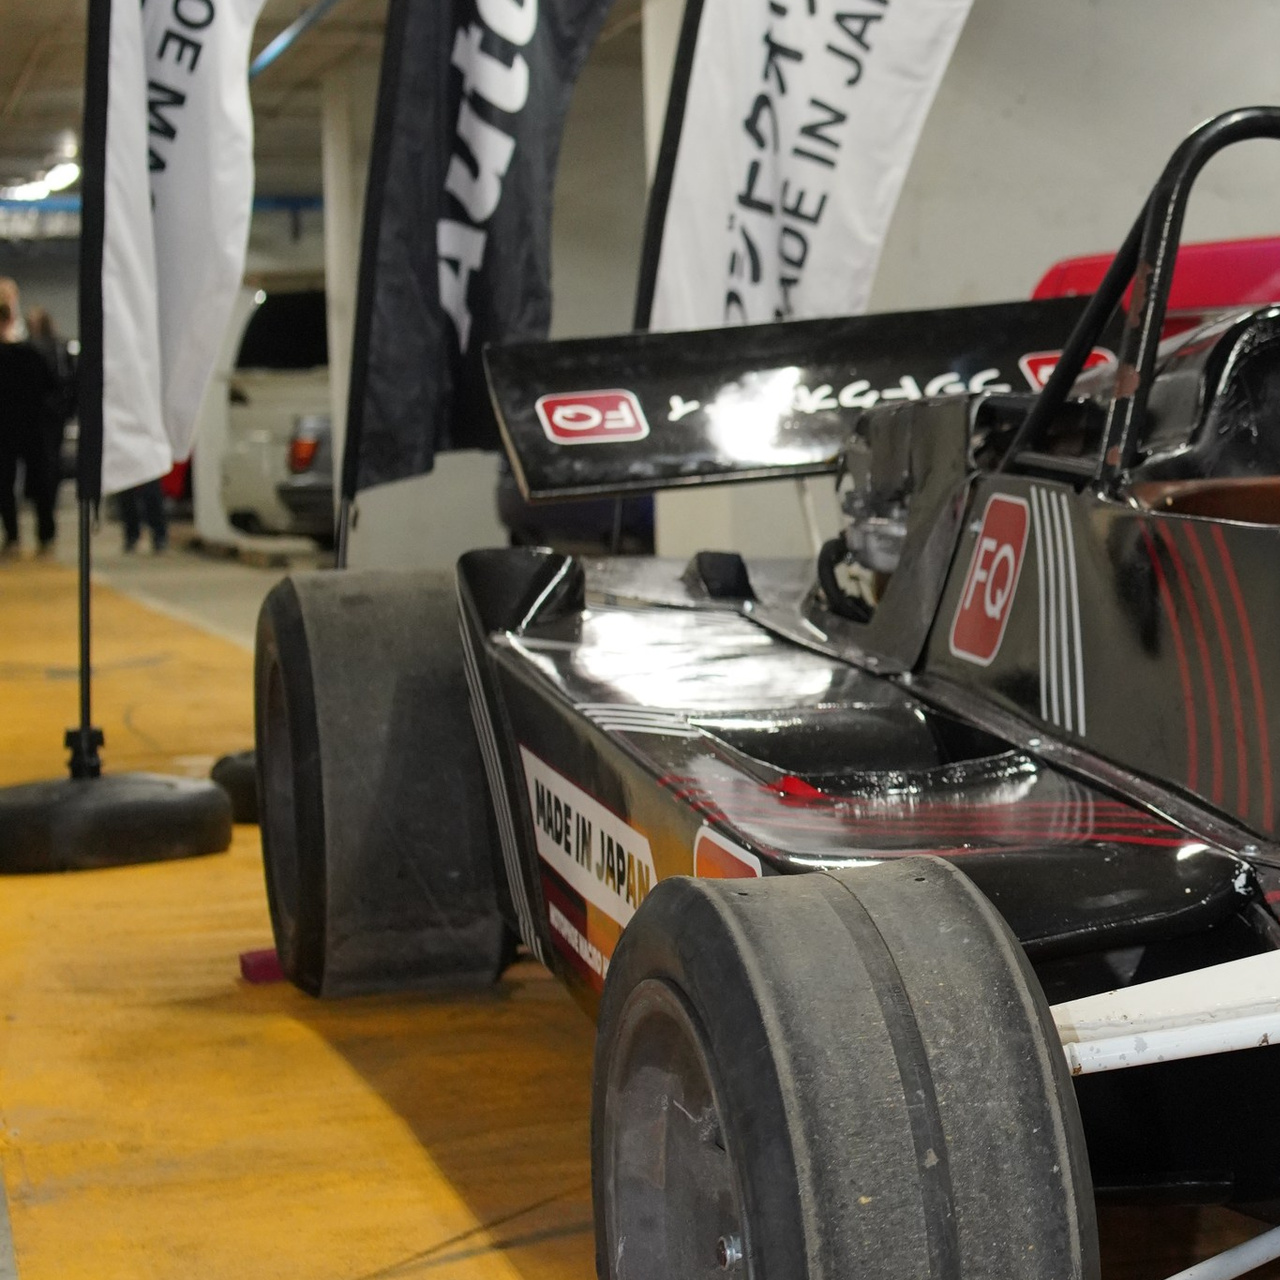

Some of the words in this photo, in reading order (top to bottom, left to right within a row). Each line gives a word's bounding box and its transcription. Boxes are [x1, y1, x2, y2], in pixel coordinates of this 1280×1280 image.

[792, 99, 848, 169] IN
[775, 179, 828, 323] ADE
[552, 400, 636, 431] FQ
[963, 537, 1017, 620] FQ
[534, 777, 572, 857] MADE
[575, 810, 592, 874] IN
[595, 827, 650, 911] JAPAN
